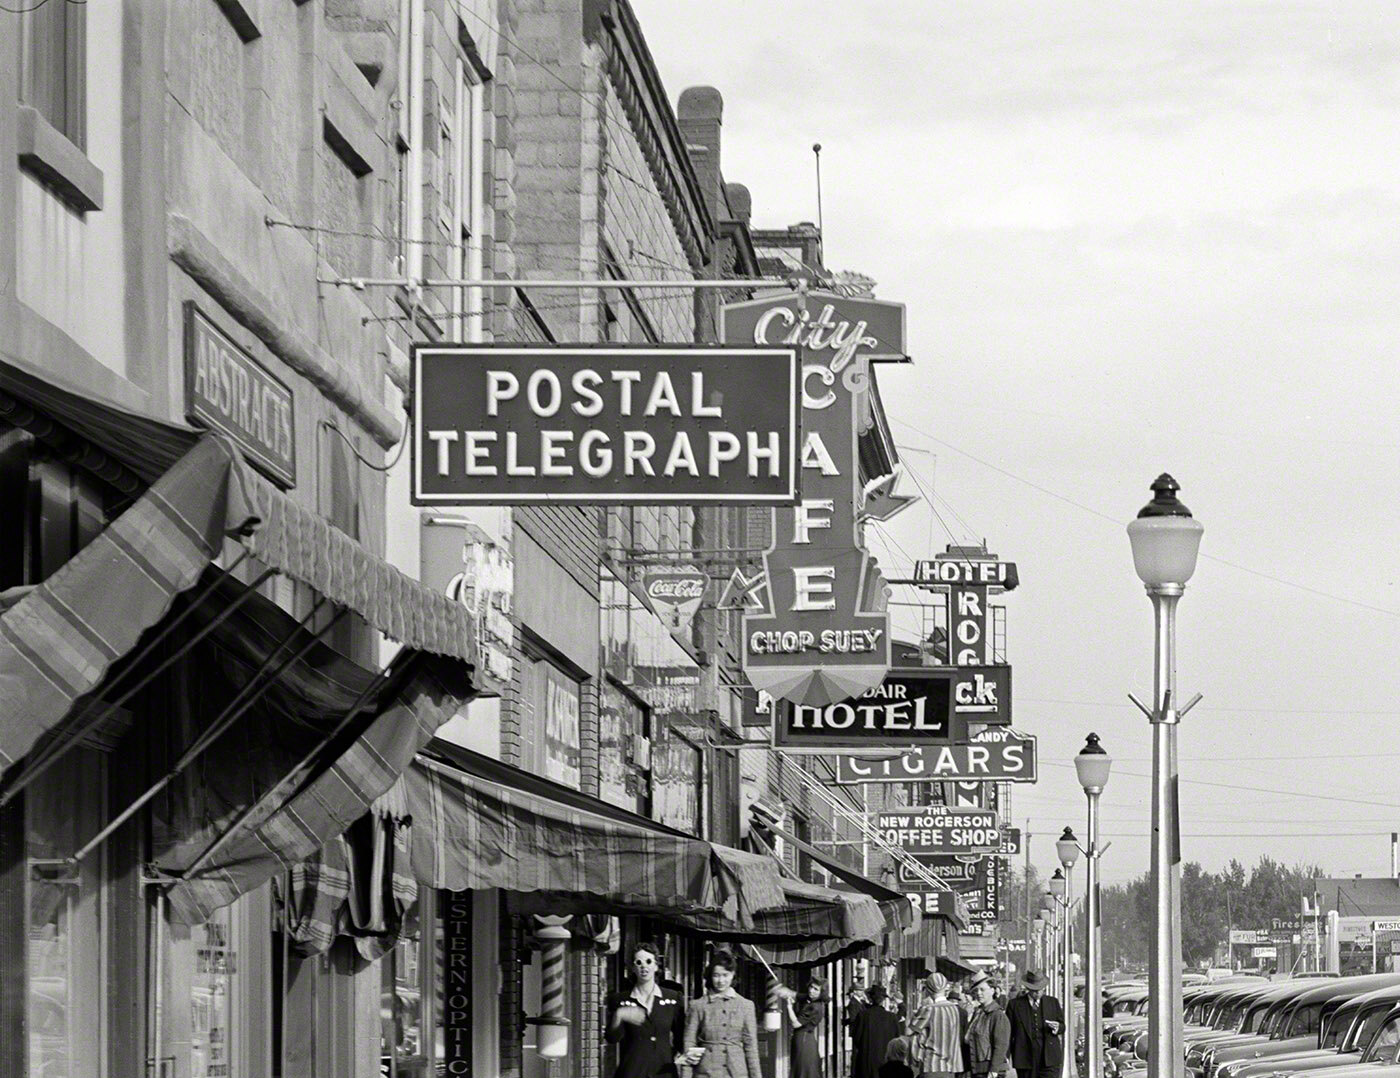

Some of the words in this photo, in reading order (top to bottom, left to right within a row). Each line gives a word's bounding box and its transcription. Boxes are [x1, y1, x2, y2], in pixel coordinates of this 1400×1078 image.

[753, 303, 878, 374] City
[195, 329, 291, 462] ABSTRACTS
[485, 368, 723, 419] POSTAL
[428, 428, 781, 478] TELEGRAPH
[792, 363, 840, 613] CAFE
[750, 630, 815, 654] CHOP
[820, 628, 883, 653] SUEY
[850, 745, 1025, 775] CIGARS
[879, 816, 909, 828] NEW
[914, 816, 993, 828] ROGERSON
[926, 806, 948, 816] THE
[950, 829, 999, 846] SHOP
